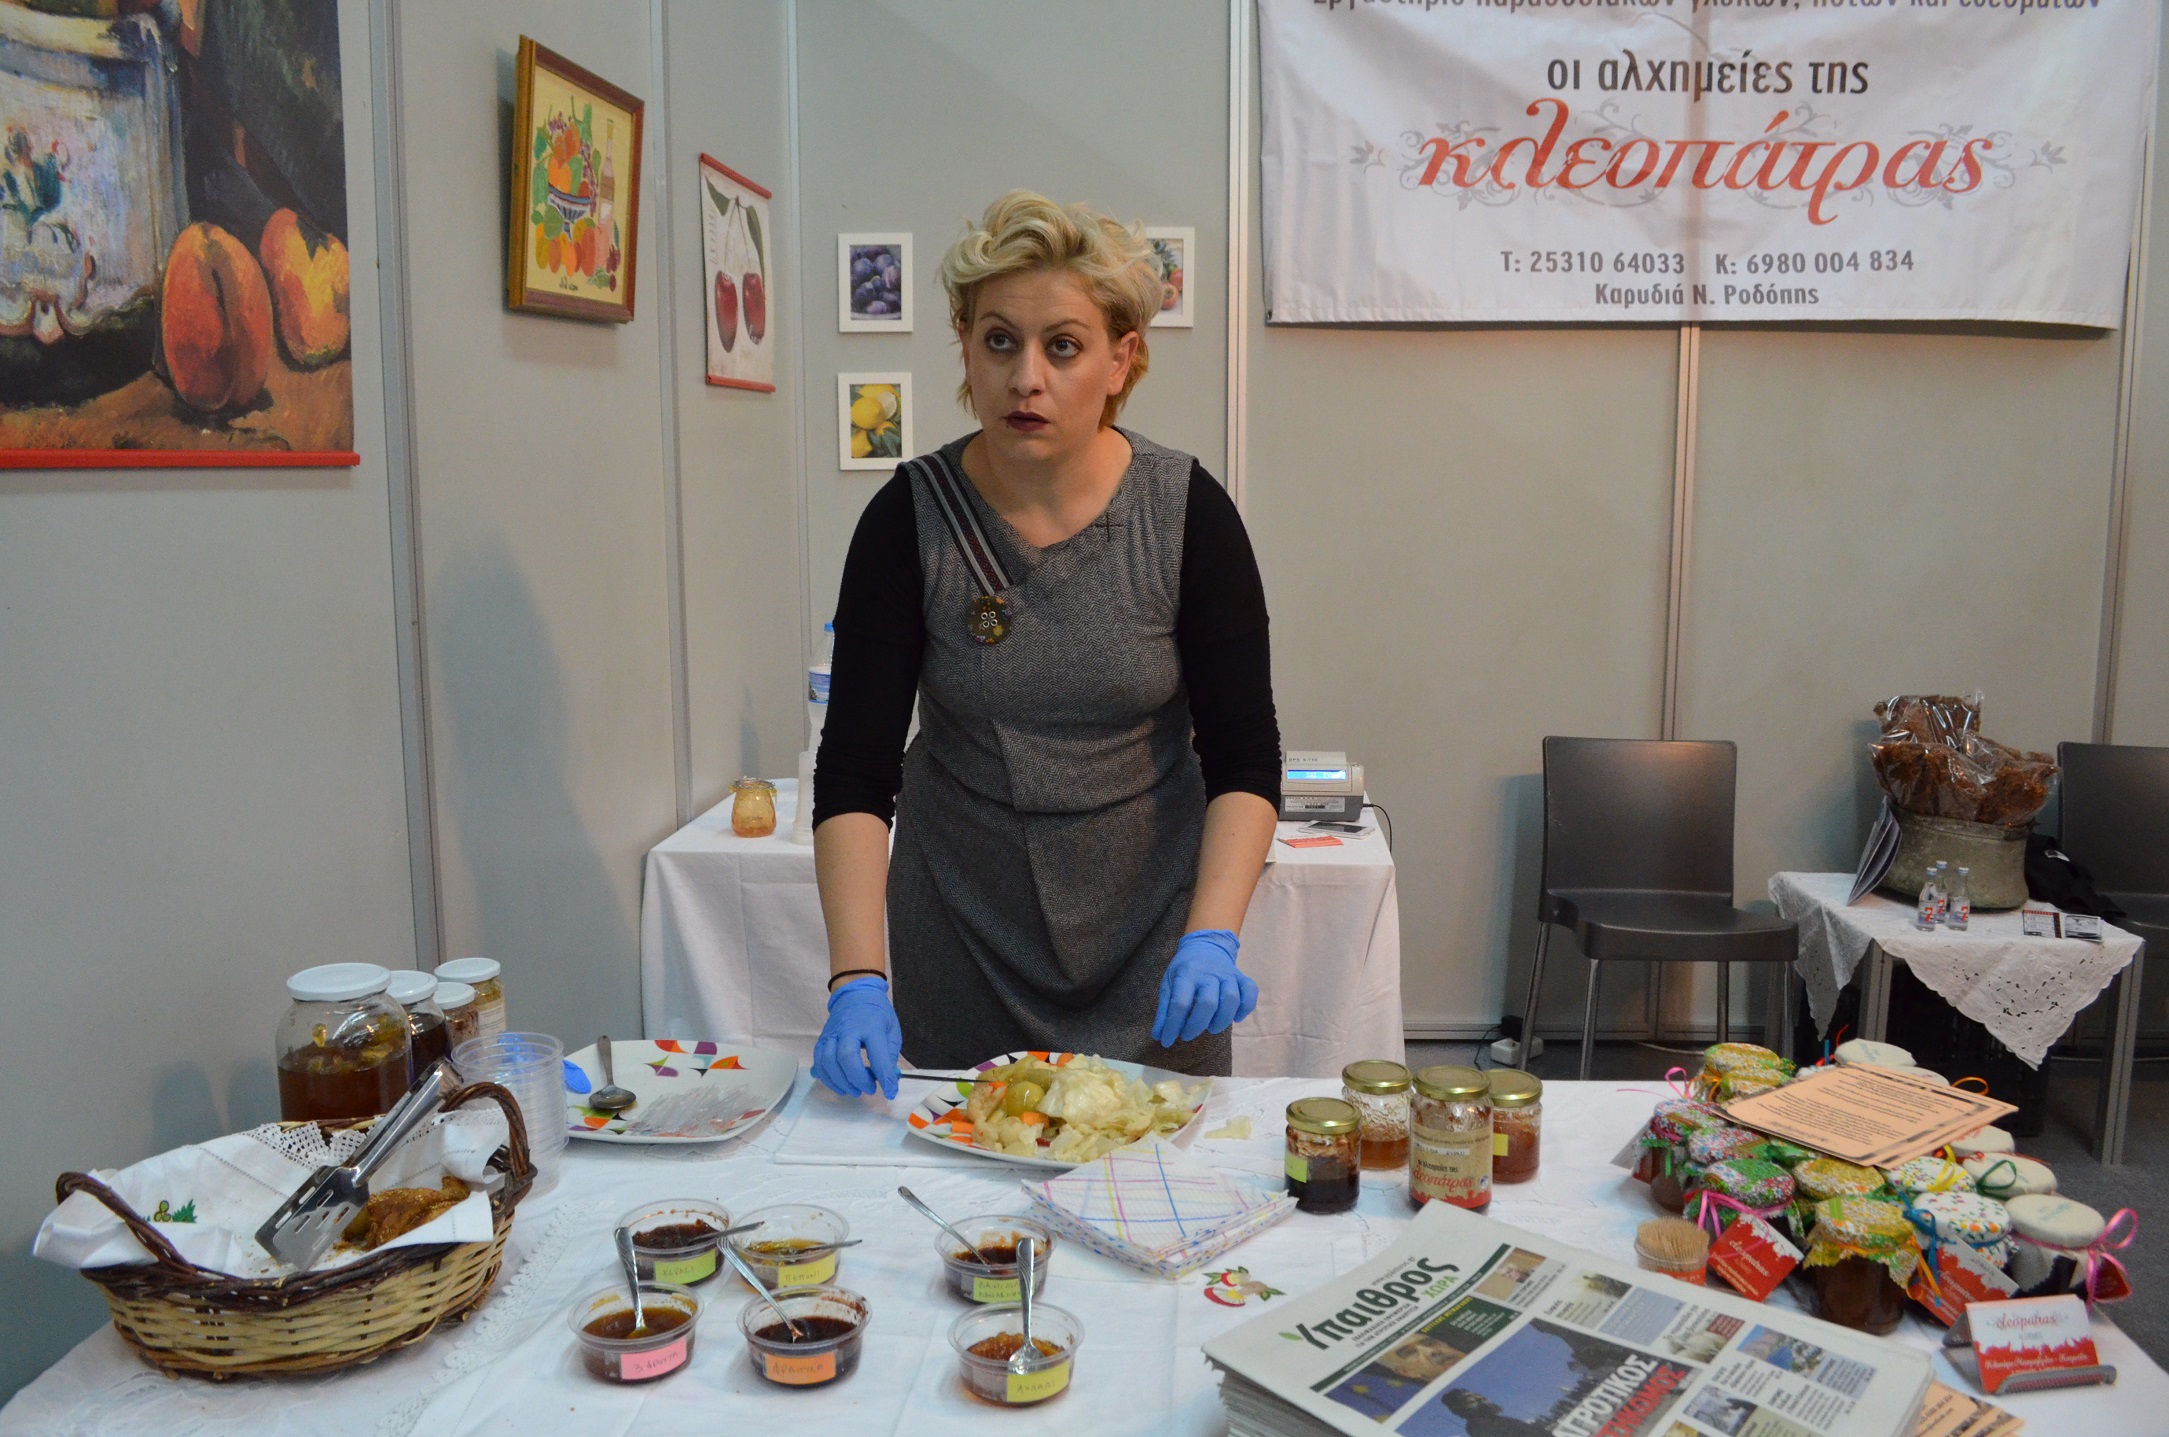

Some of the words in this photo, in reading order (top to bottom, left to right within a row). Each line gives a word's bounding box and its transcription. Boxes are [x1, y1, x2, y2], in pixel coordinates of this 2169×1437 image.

[1546, 60, 1582, 91] οι
[1597, 51, 1793, 102] αλχημείες
[1808, 58, 1869, 95] της
[1416, 97, 1995, 226] κλεοπάτρας
[1529, 250, 1604, 275] 25310
[1612, 251, 1686, 275] 64033
[1746, 252, 1806, 275] 6980
[1814, 251, 1860, 274] 004
[1869, 250, 1915, 272] 834
[1595, 283, 1685, 309] Καρυδιά
[1723, 283, 1820, 306] Ροδόπης
[1413, 1166, 1473, 1192] λεοπάτρας
[1996, 1312, 2058, 1331] cleopatras
